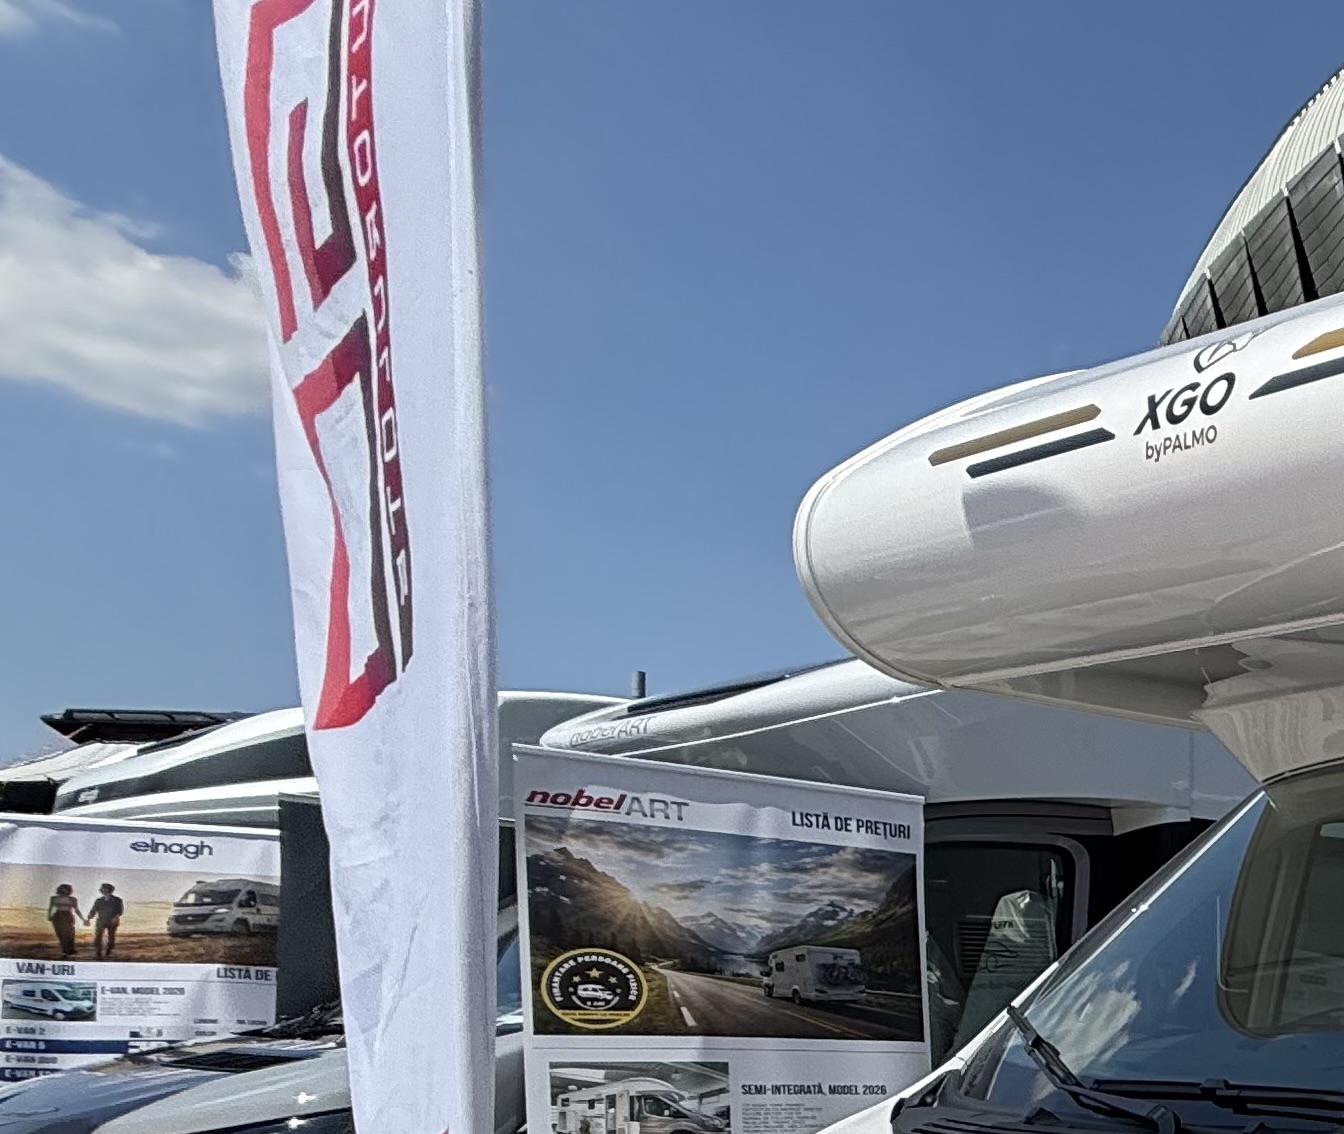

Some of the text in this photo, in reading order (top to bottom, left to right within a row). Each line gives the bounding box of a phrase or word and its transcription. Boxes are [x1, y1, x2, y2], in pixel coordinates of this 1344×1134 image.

[1133, 371, 1237, 437] XGO
[1144, 424, 1218, 463] byPALMO
[525, 787, 690, 822] nobelART
[791, 810, 830, 831] LISTĂ
[834, 817, 853, 834] DE
[130, 838, 214, 860] elnagh
[16, 961, 76, 976] VAN-URI
[255, 969, 273, 983] DE
[828, 1084, 861, 1096] MODEL
[863, 1084, 888, 1096] 2026
